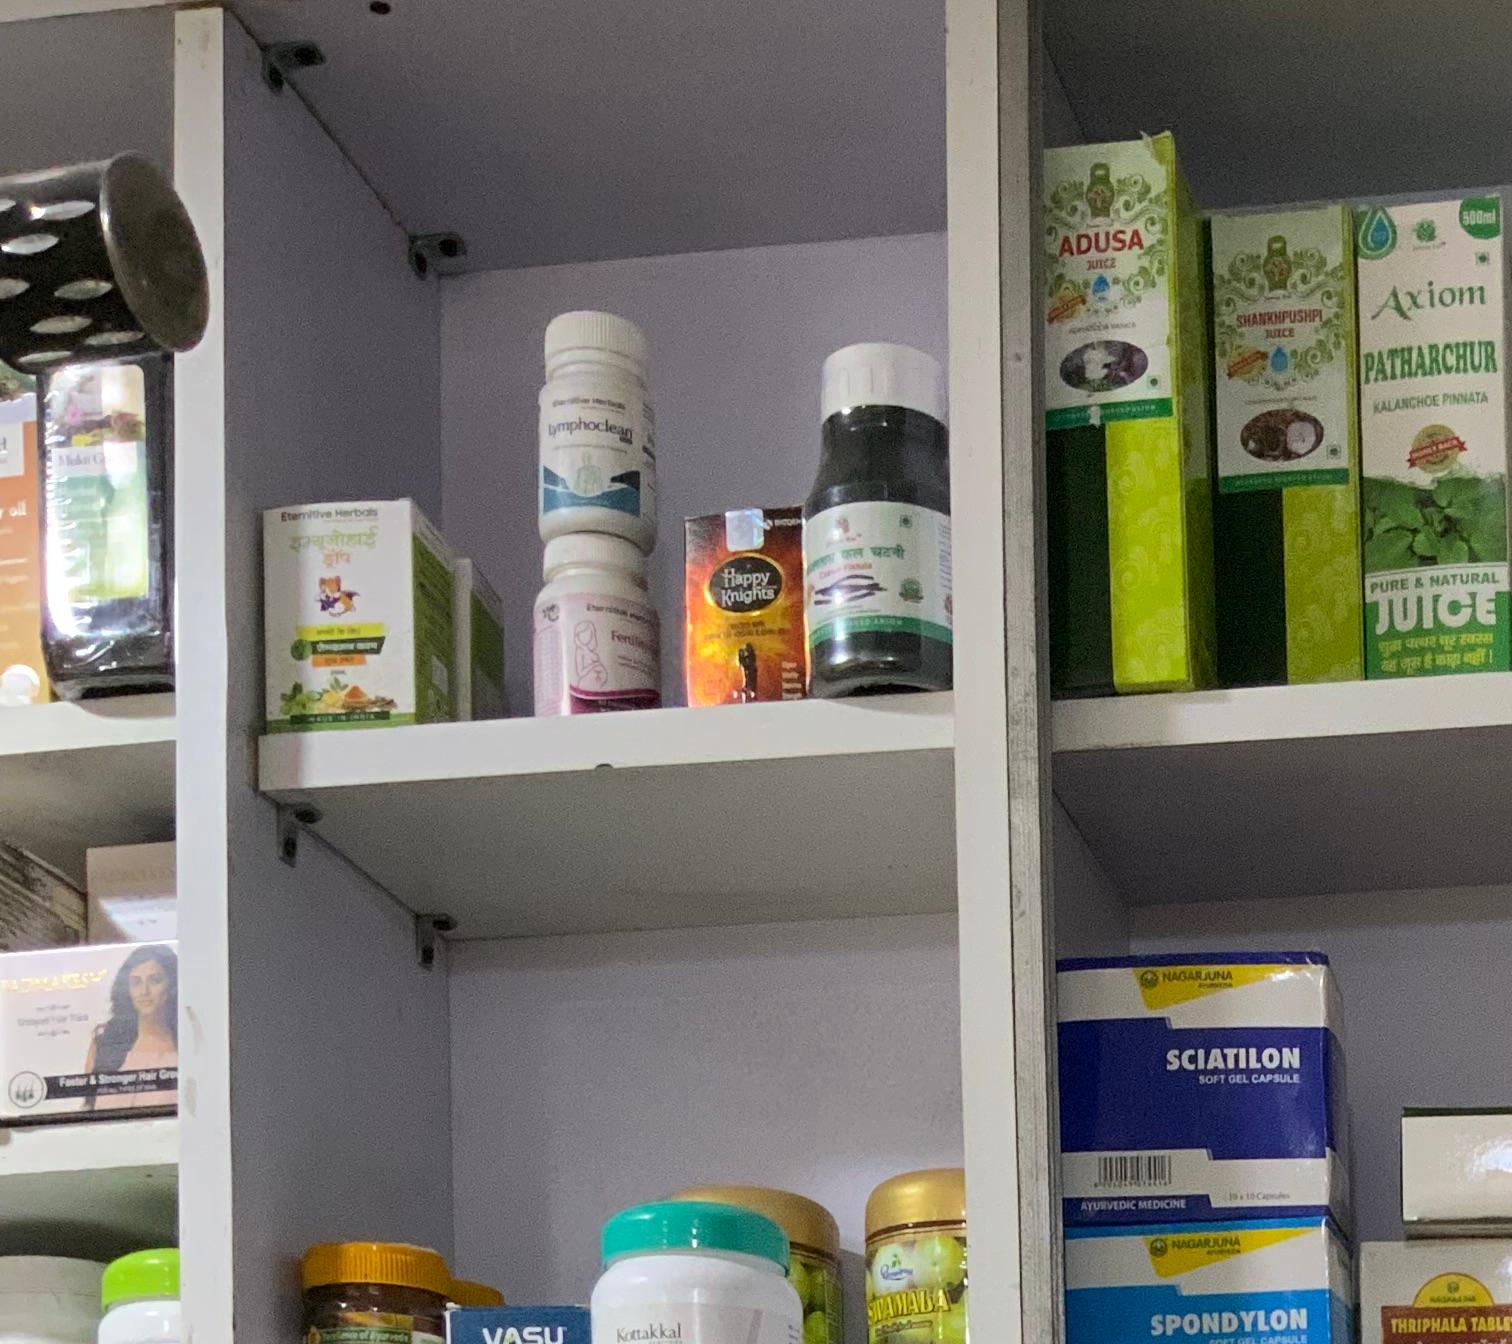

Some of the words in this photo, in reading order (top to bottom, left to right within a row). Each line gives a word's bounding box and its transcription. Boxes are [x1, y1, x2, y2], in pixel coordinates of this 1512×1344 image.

[1461, 208, 1497, 226] 500ml
[1058, 228, 1144, 257] ADUSA
[1371, 281, 1486, 321] Axiom
[1236, 308, 1324, 329] SHANKHPUSHPI
[1264, 326, 1295, 340] JUICE
[1363, 341, 1497, 385] PATHARCHUR
[1442, 391, 1488, 408] PINNATA
[548, 416, 633, 440] Lymphoclean
[334, 506, 379, 520] Herbals
[722, 567, 770, 590] Happy
[1370, 578, 1410, 595] PURE
[1430, 571, 1499, 587] NATURAL
[721, 587, 775, 606] Knights
[1376, 590, 1497, 635] JUICE
[1162, 969, 1233, 984] NAGARJUNA
[1166, 1047, 1300, 1072] SCIATILON
[139, 1070, 158, 1082] Hair
[1198, 1074, 1226, 1085] SOFT
[1228, 1073, 1250, 1085] GEL
[1251, 1073, 1300, 1084] CAPSULE
[1080, 1199, 1137, 1212] AYURVEDIC
[1138, 1199, 1187, 1211] MEDICINE
[1171, 1236, 1242, 1251] NAGARJUNA
[1150, 1308, 1309, 1338] SPONDYLON
[1391, 1317, 1468, 1334] THRIPHALA
[615, 1323, 683, 1344] Kottakkal
